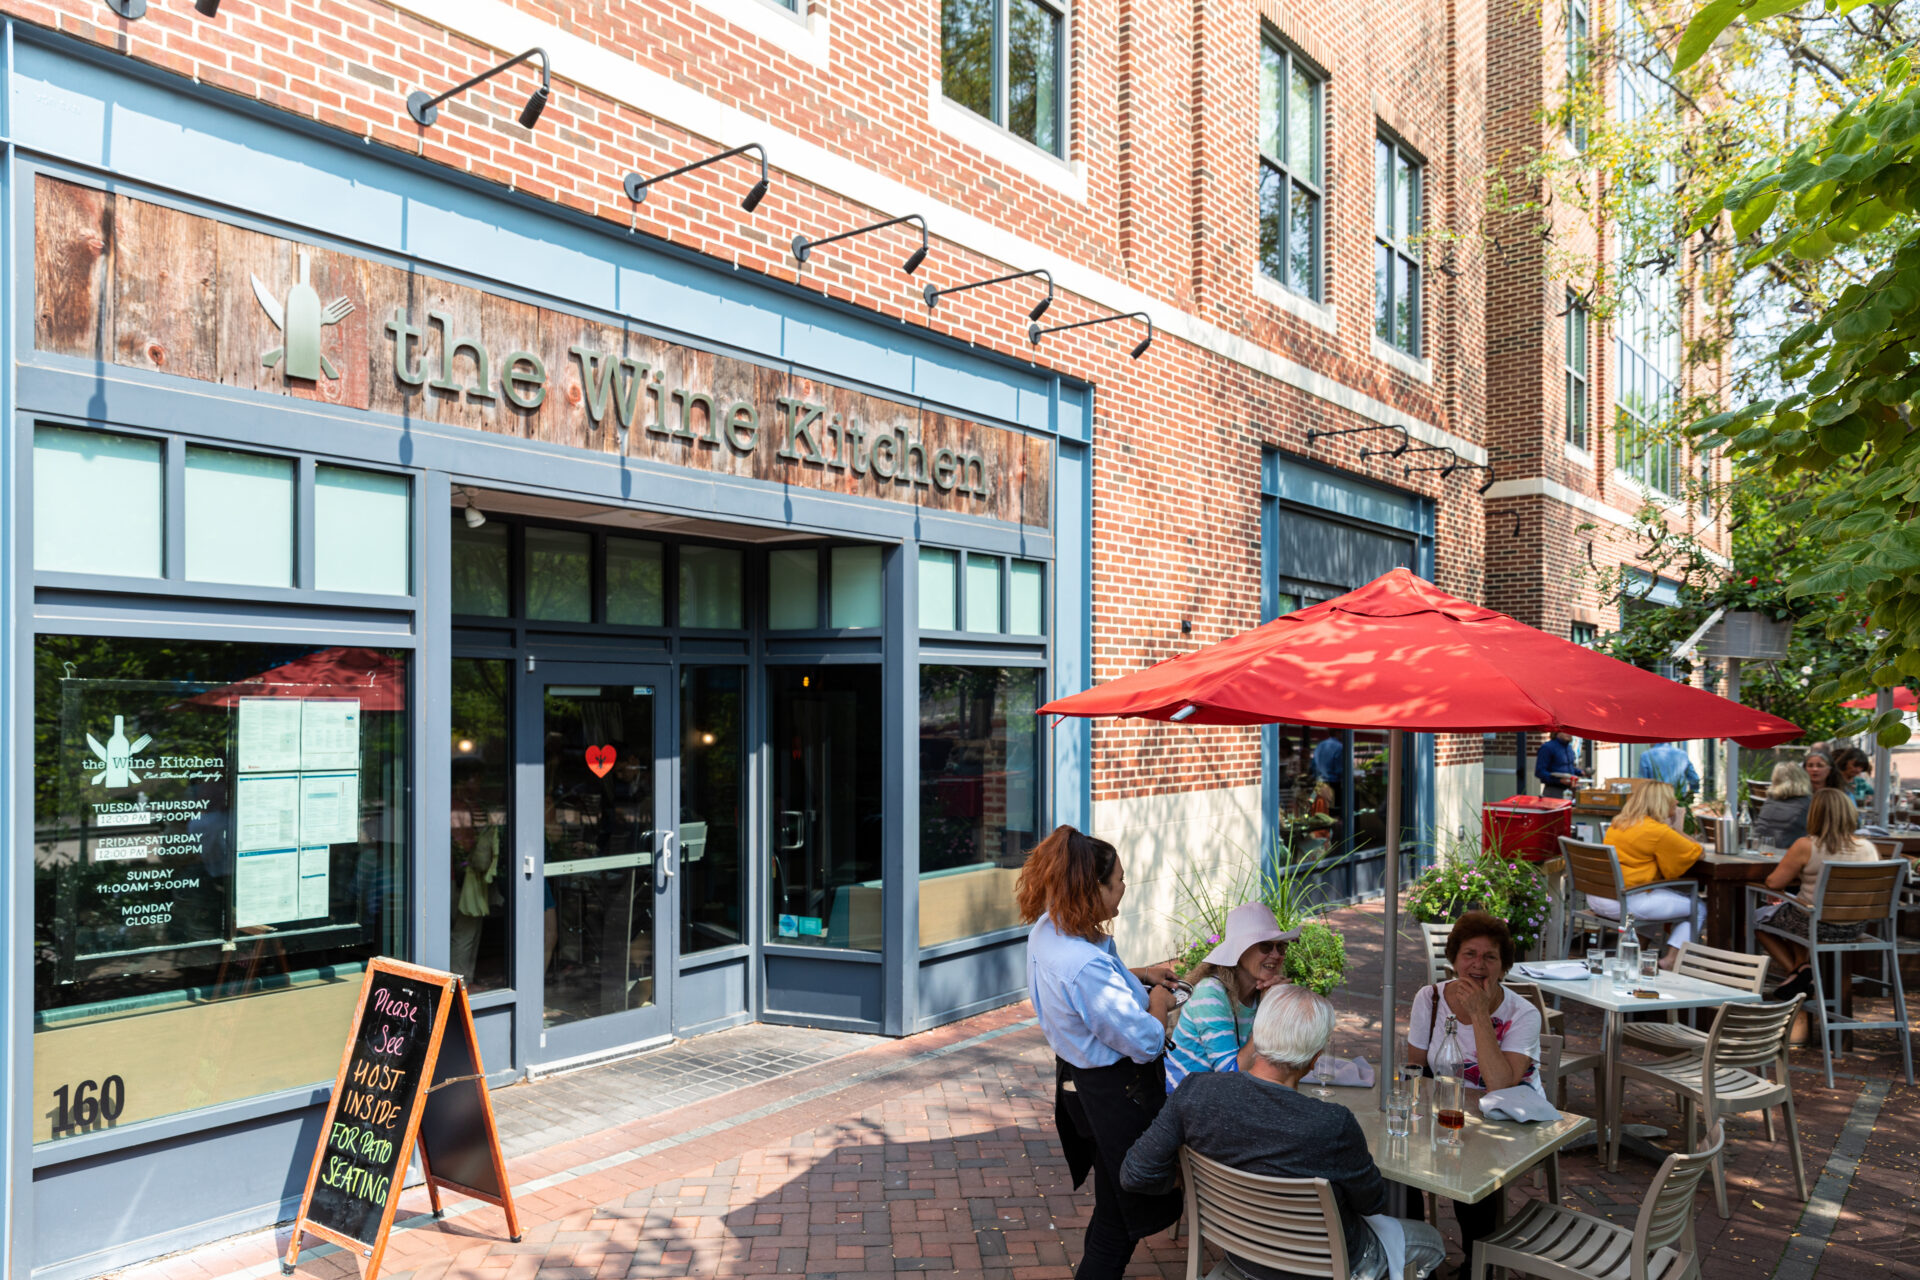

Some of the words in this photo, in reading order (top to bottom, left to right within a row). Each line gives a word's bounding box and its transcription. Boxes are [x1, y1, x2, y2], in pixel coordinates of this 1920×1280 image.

[384, 308, 547, 409] the
[569, 345, 759, 451] Wine
[777, 397, 990, 496] Kitchen
[82, 759, 106, 770] the
[112, 756, 156, 769] Wine
[158, 755, 225, 769] Kitchen
[92, 799, 210, 814] TUESDAY-THURSDAY
[98, 833, 203, 848] FRIDAY-SATURDAY
[126, 868, 175, 881] SUNDAY
[121, 901, 175, 916] MONDAY
[125, 913, 173, 927] CLOSED
[374, 987, 418, 1023] Please
[374, 1024, 405, 1056] See
[353, 1058, 406, 1092] HOST
[53, 1074, 125, 1134] 160
[344, 1090, 402, 1129] INSIDE
[329, 1121, 360, 1154] FOR
[360, 1130, 393, 1164] PATIO
[322, 1155, 391, 1208] SEATING
